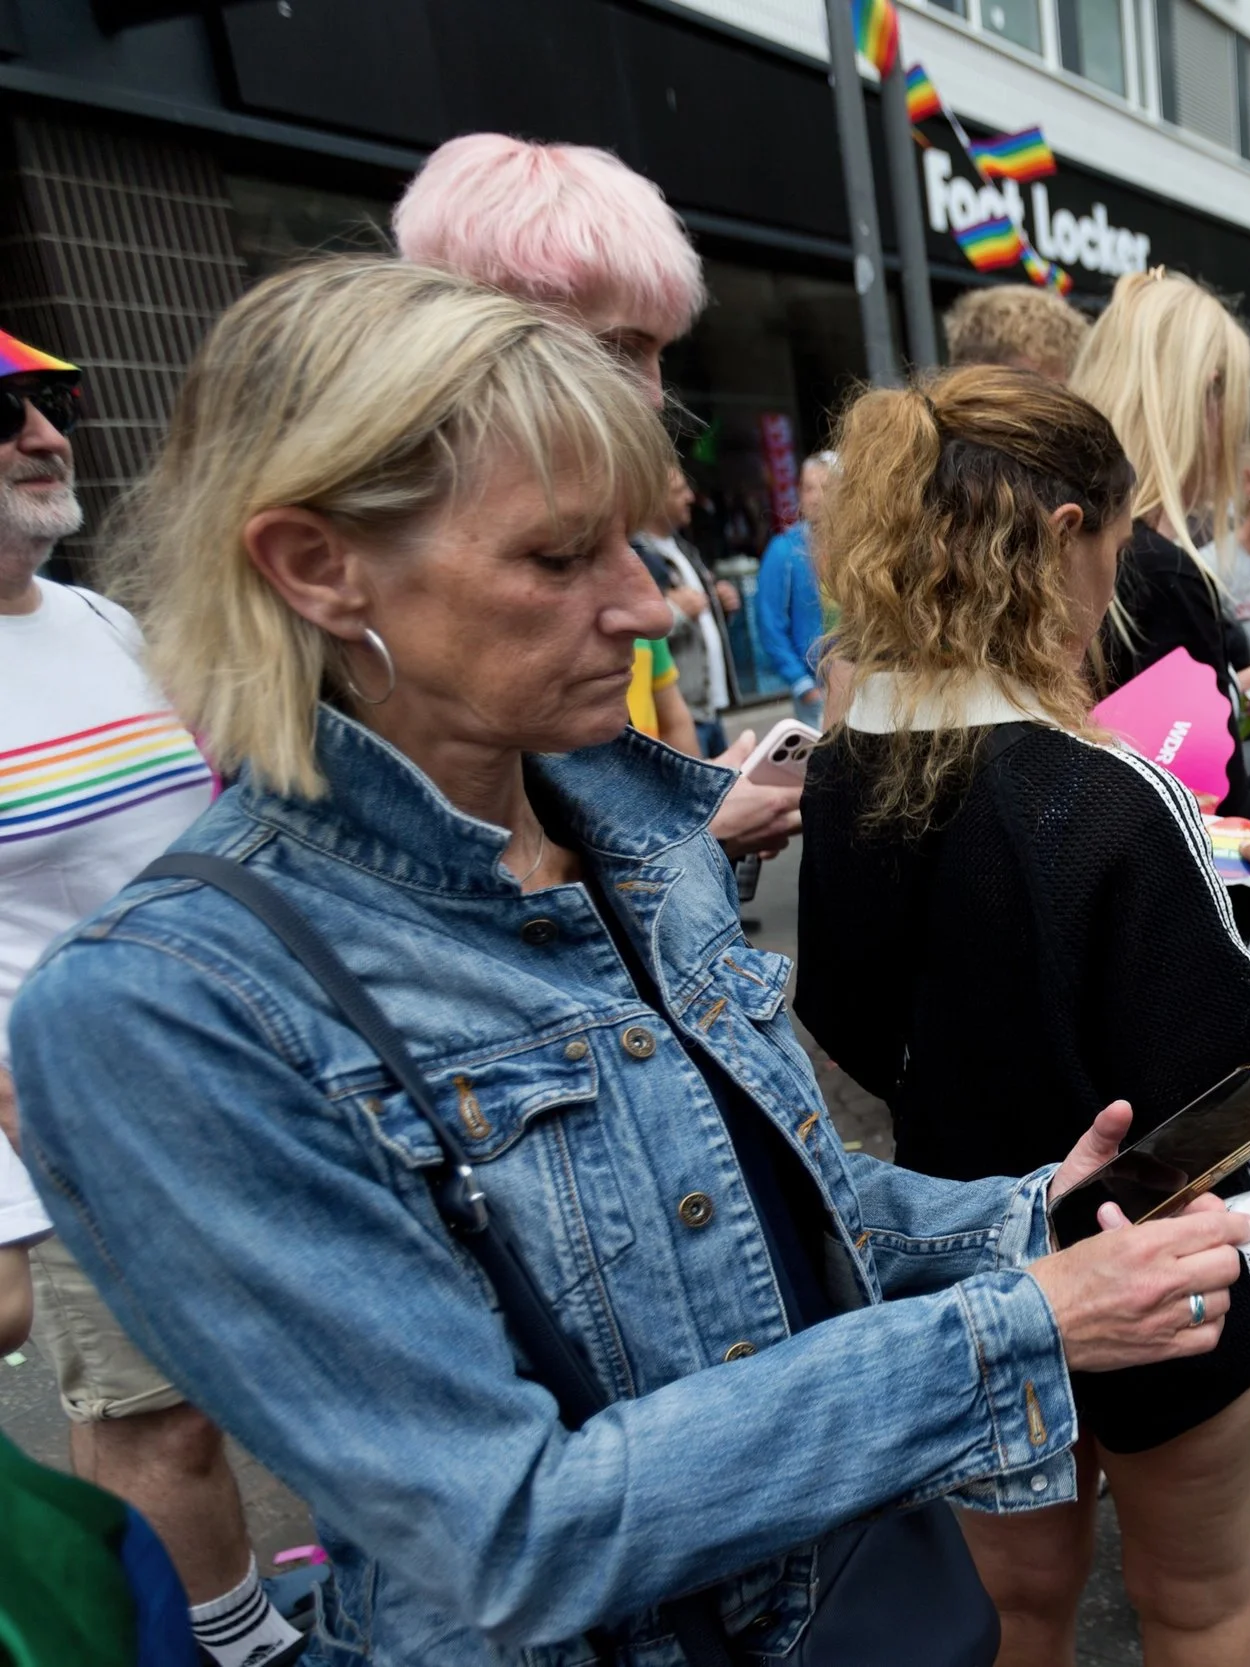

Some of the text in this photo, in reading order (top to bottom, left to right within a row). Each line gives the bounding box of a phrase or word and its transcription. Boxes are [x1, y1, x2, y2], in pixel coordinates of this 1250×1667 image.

[923, 147, 1151, 277] Foot Locker
[1154, 720, 1192, 765] WDR
